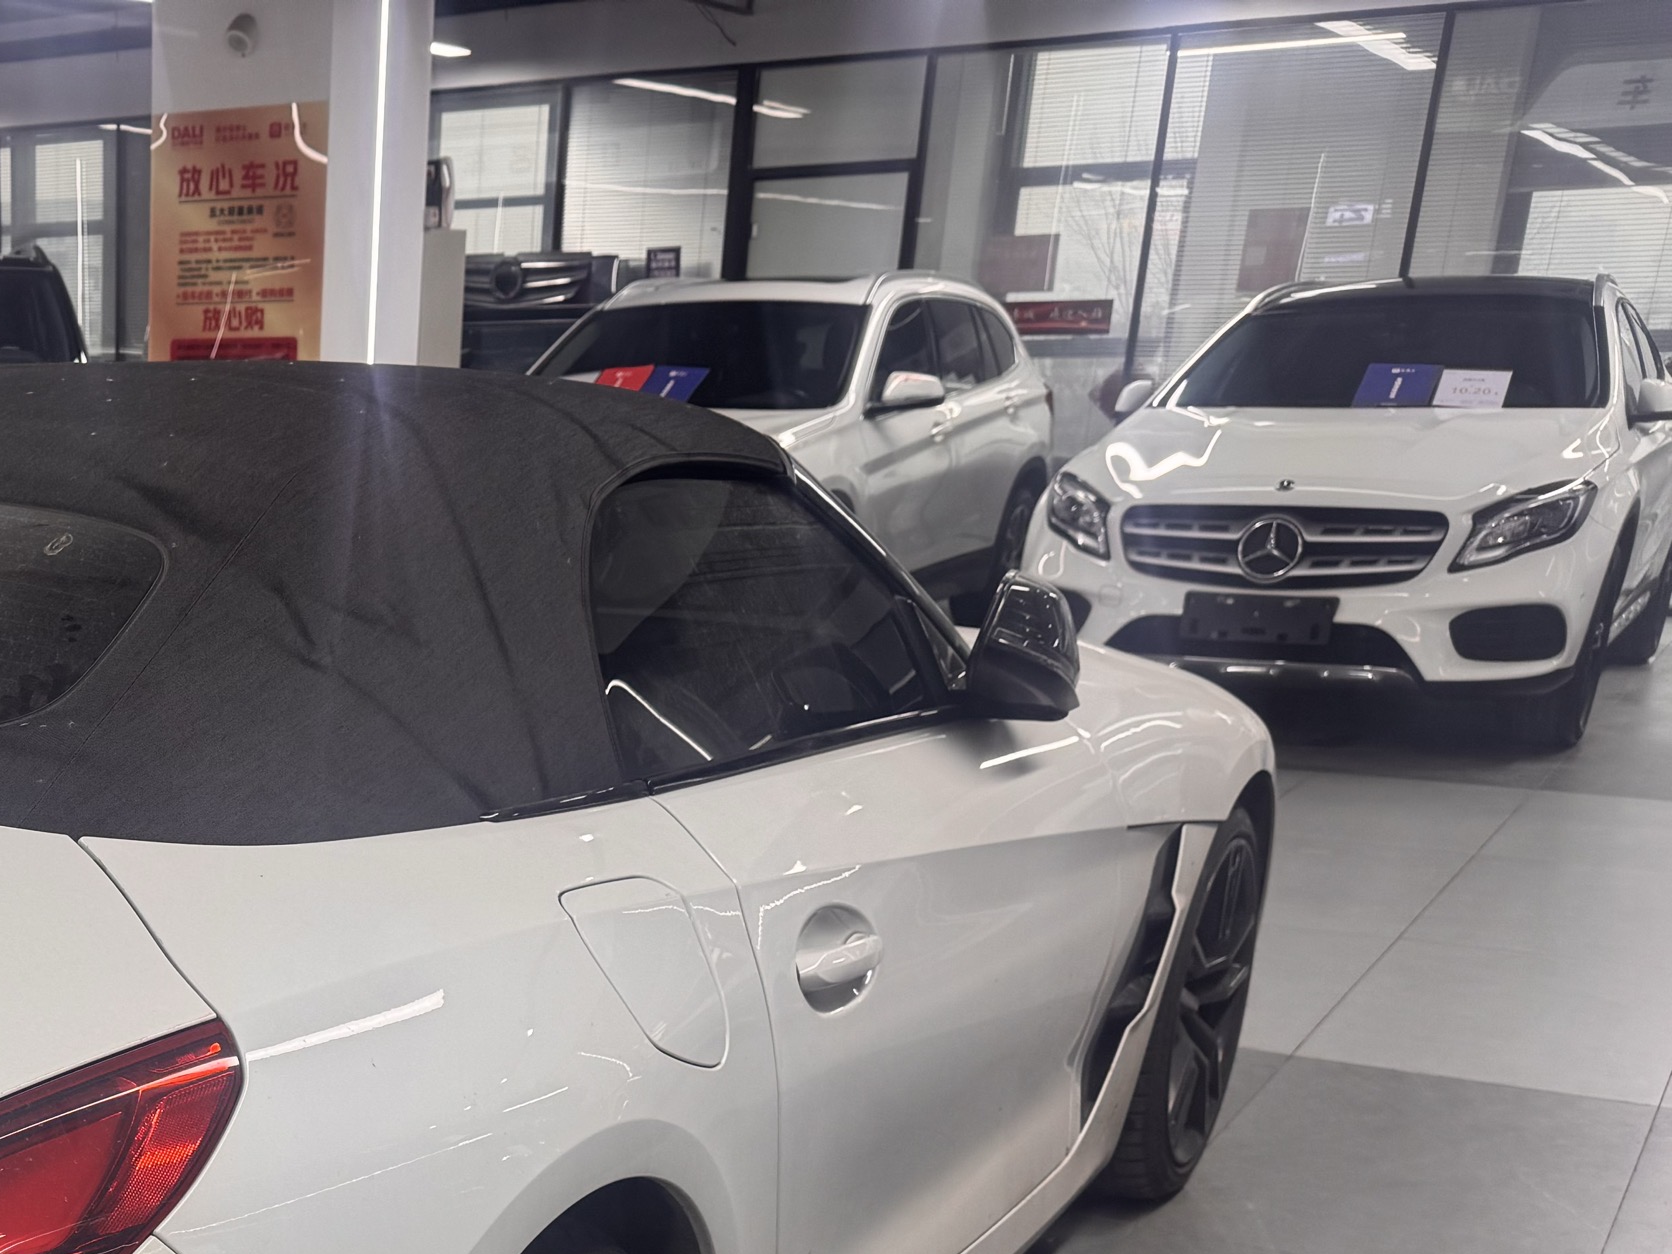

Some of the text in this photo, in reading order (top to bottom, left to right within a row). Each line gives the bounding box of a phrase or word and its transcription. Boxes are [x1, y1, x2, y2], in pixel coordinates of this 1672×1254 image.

[171, 125, 204, 141] DALI
[178, 159, 298, 198] 放心车况
[202, 304, 265, 333] 放心购
